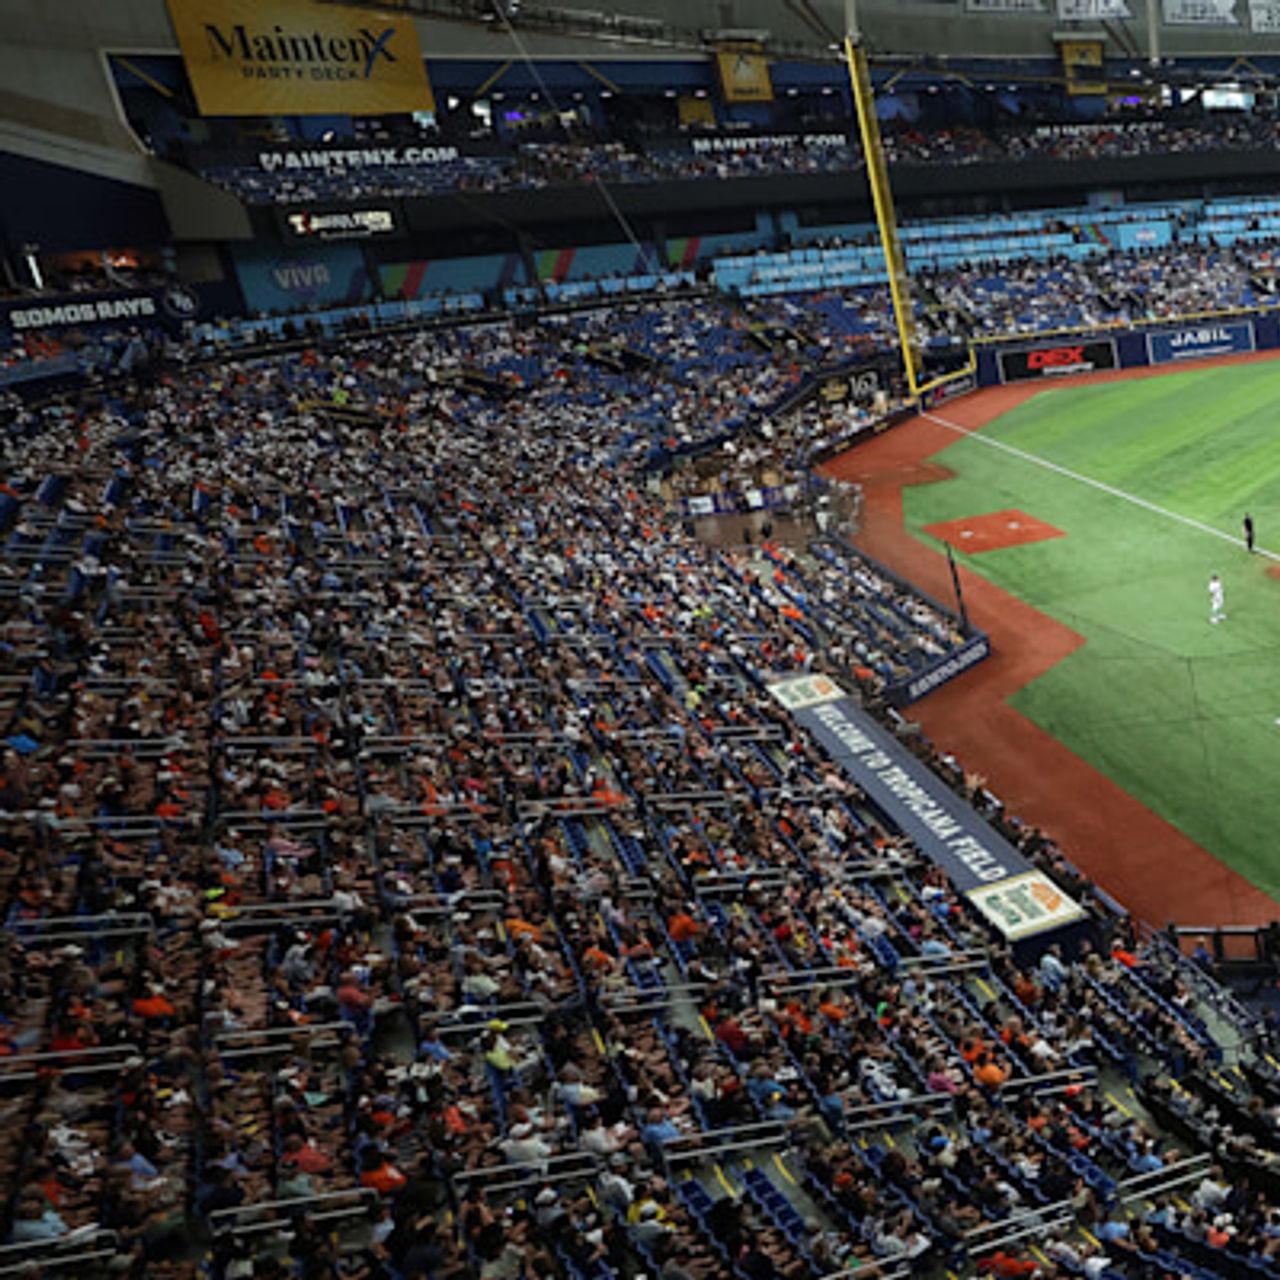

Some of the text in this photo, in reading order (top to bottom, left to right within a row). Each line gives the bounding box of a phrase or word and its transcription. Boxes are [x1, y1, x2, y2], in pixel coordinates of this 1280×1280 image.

[258, 146, 460, 172] MAINTENX.COM
[10, 298, 156, 329] SOMOS RAYS
[1169, 327, 1232, 348] JABIL
[1027, 346, 1085, 369] DEX
[811, 703, 1010, 881] WELCOME TO TROPICANA FIELD
